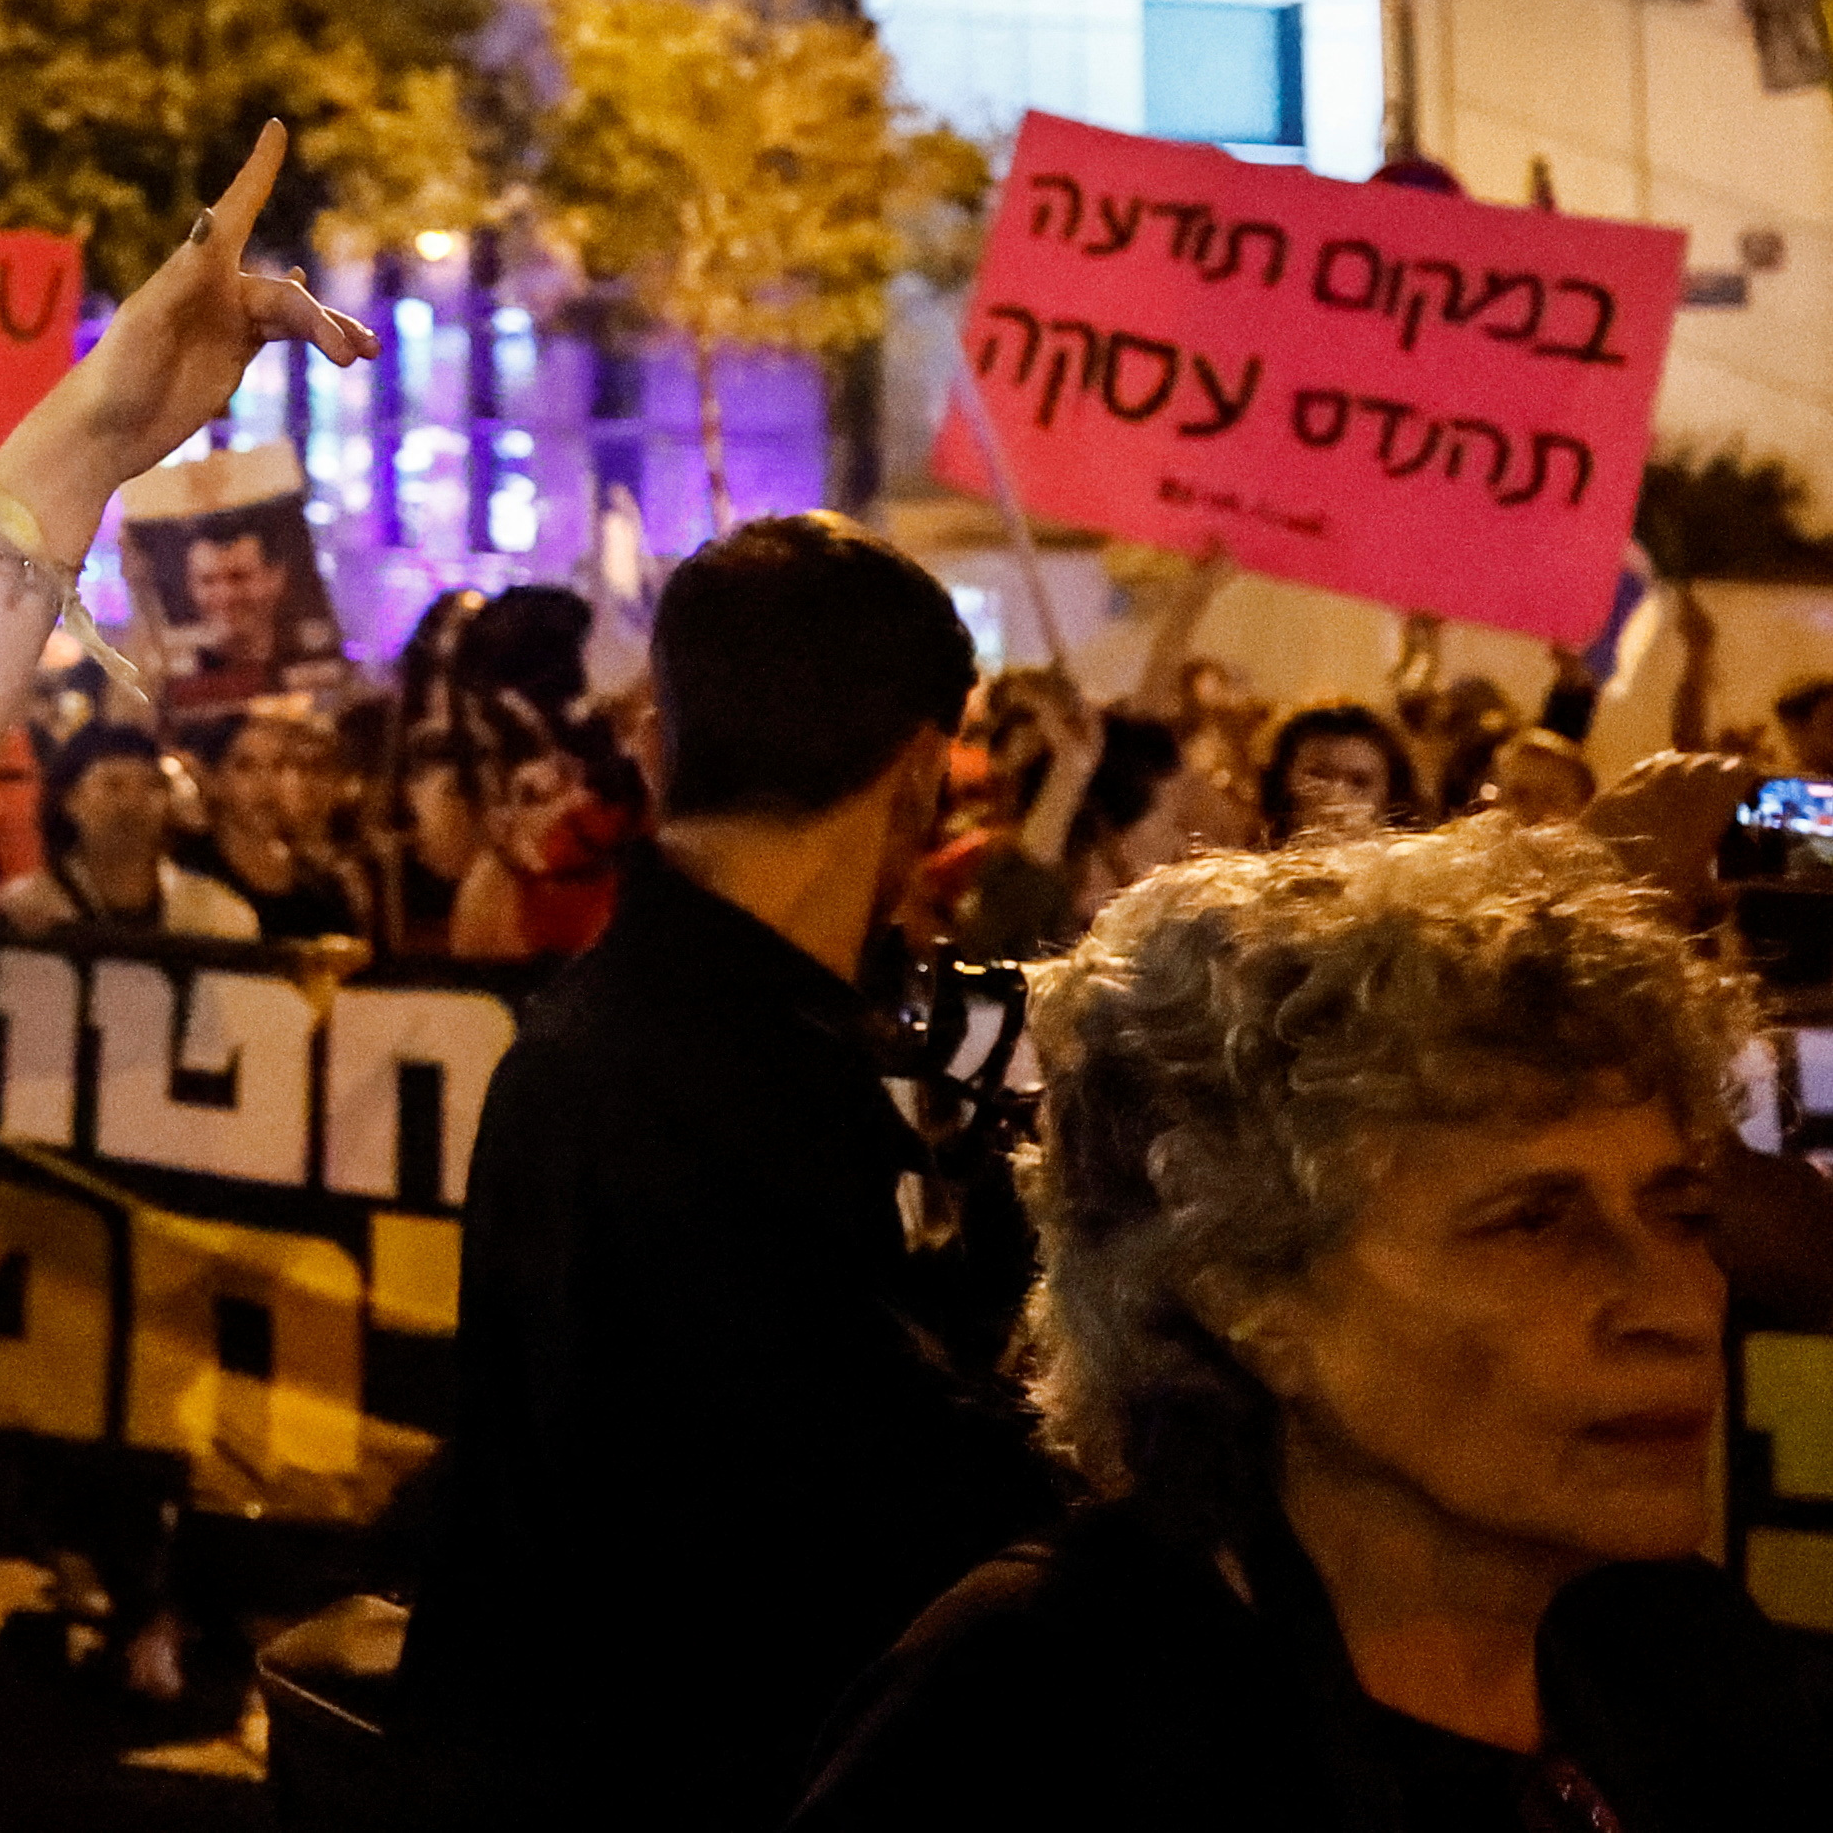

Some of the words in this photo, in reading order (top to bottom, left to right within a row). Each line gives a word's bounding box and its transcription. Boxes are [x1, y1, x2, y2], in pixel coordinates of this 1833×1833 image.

[1028, 172, 1290, 286] תודעה
[1312, 237, 1625, 366] במקום
[977, 303, 1265, 438] עסקה
[1293, 384, 1594, 506] תהנדס
